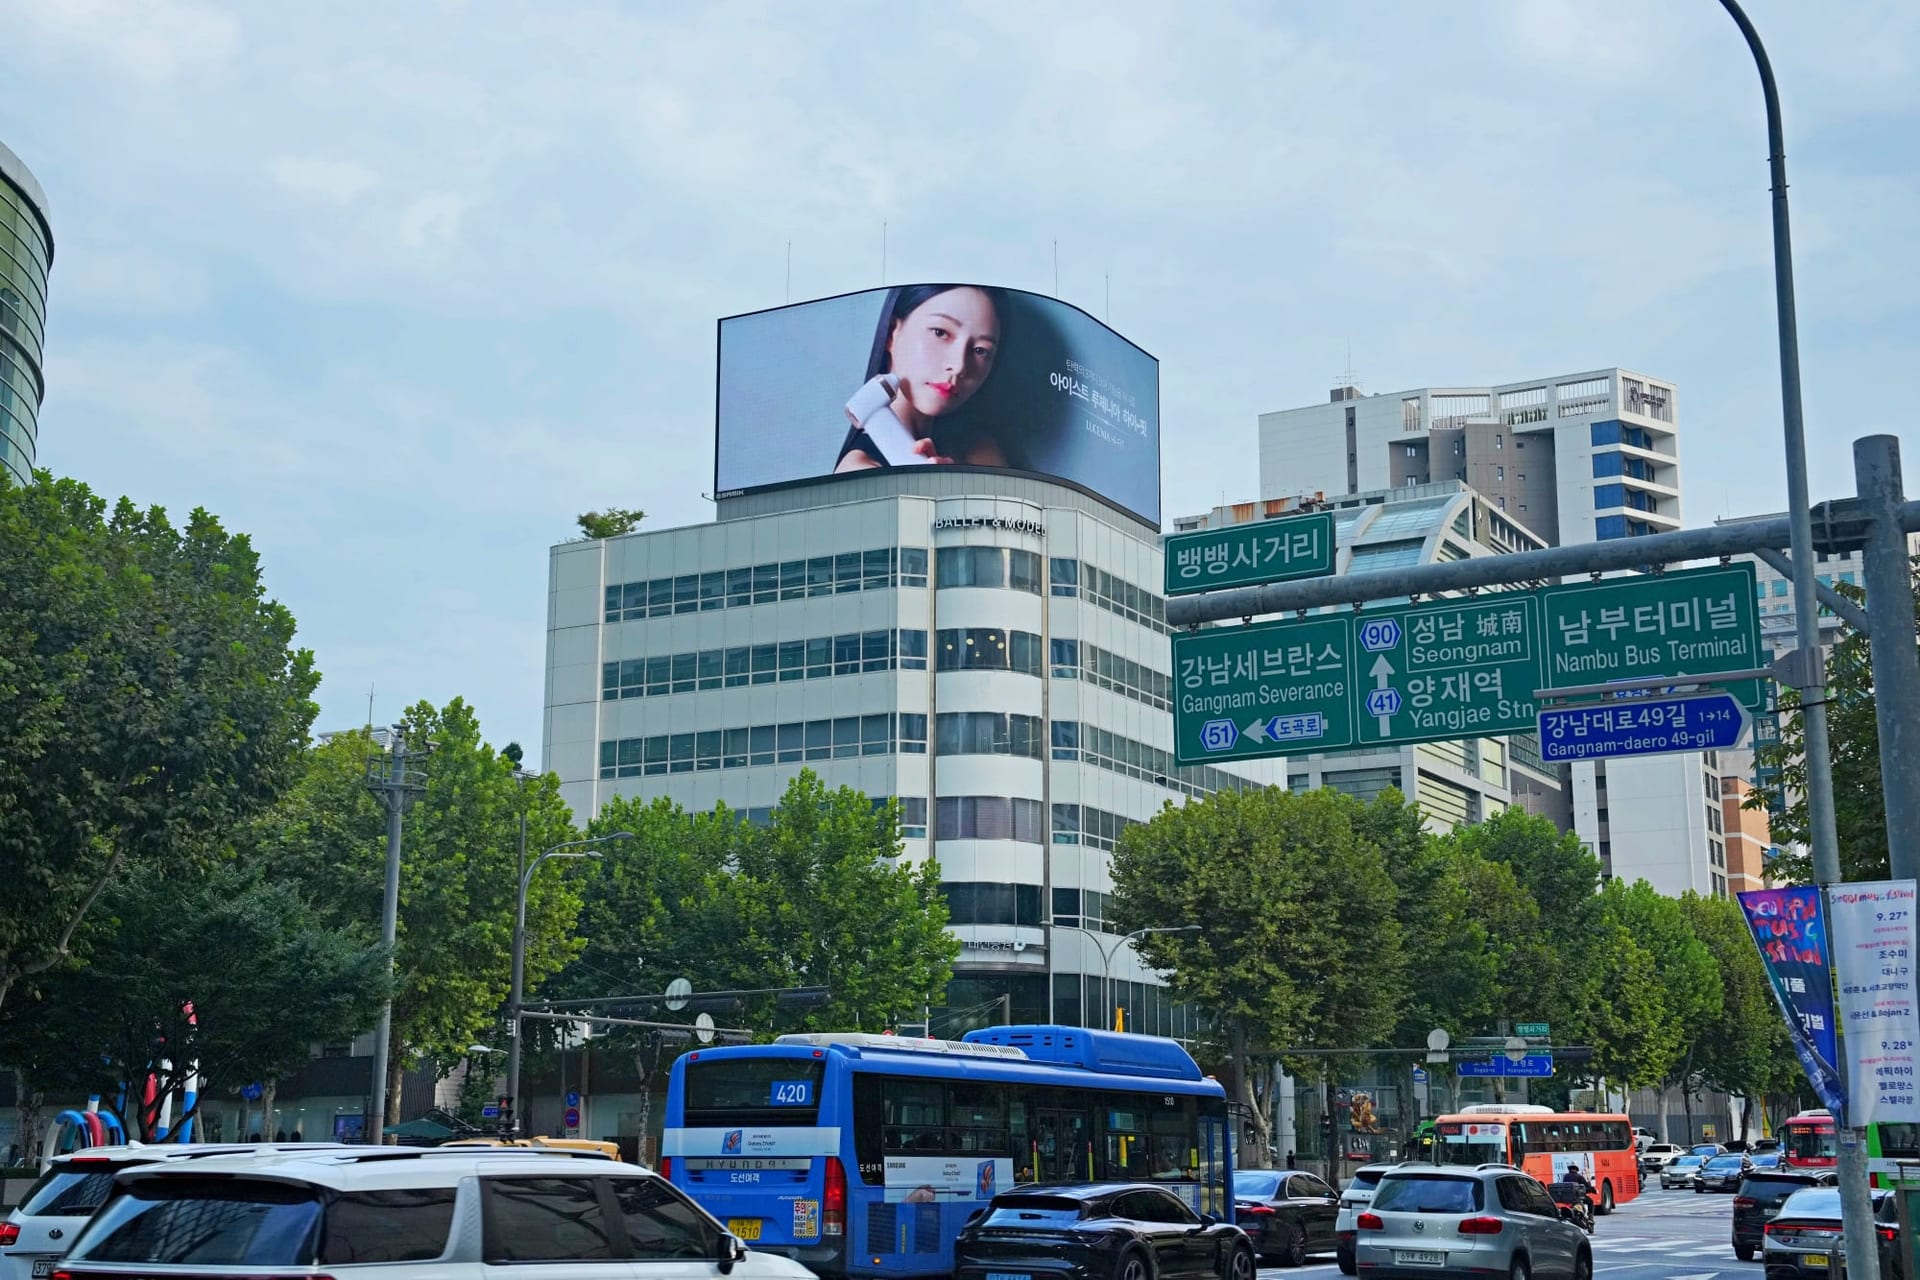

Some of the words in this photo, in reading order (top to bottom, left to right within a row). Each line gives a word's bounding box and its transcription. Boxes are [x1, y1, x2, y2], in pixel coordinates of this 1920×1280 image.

[1050, 372, 1089, 402] 아이스트
[935, 515, 988, 529] BALLET
[992, 517, 1001, 527] &
[1177, 529, 1318, 578] 뱅뱅사거리
[1412, 613, 1464, 644] 성남
[1476, 610, 1522, 637] 城南
[1559, 593, 1738, 646] 남부터미널
[1368, 625, 1392, 645] 90
[1412, 640, 1521, 664] Seongnam
[1556, 649, 1618, 674] Nambu
[1625, 645, 1661, 666] Bus
[1667, 633, 1747, 662] Terminal
[1181, 643, 1342, 689] 강남세브란스
[1182, 689, 1256, 714] Gangnam
[1258, 681, 1344, 704] Severance
[1407, 668, 1503, 708] 양재역
[1374, 694, 1393, 711] 41
[1279, 719, 1319, 736] 도곡로
[1409, 706, 1491, 729] Yangjae
[1546, 704, 1686, 739] 강남대로49길
[1208, 726, 1229, 745] 51
[1548, 735, 1667, 758] Gangnam-daero
[1671, 729, 1714, 749] 49-gil
[1879, 949, 1908, 959] 조수미
[777, 1084, 806, 1103] 420
[1164, 1096, 1174, 1106] 1510
[730, 1173, 760, 1183] 도선여객
